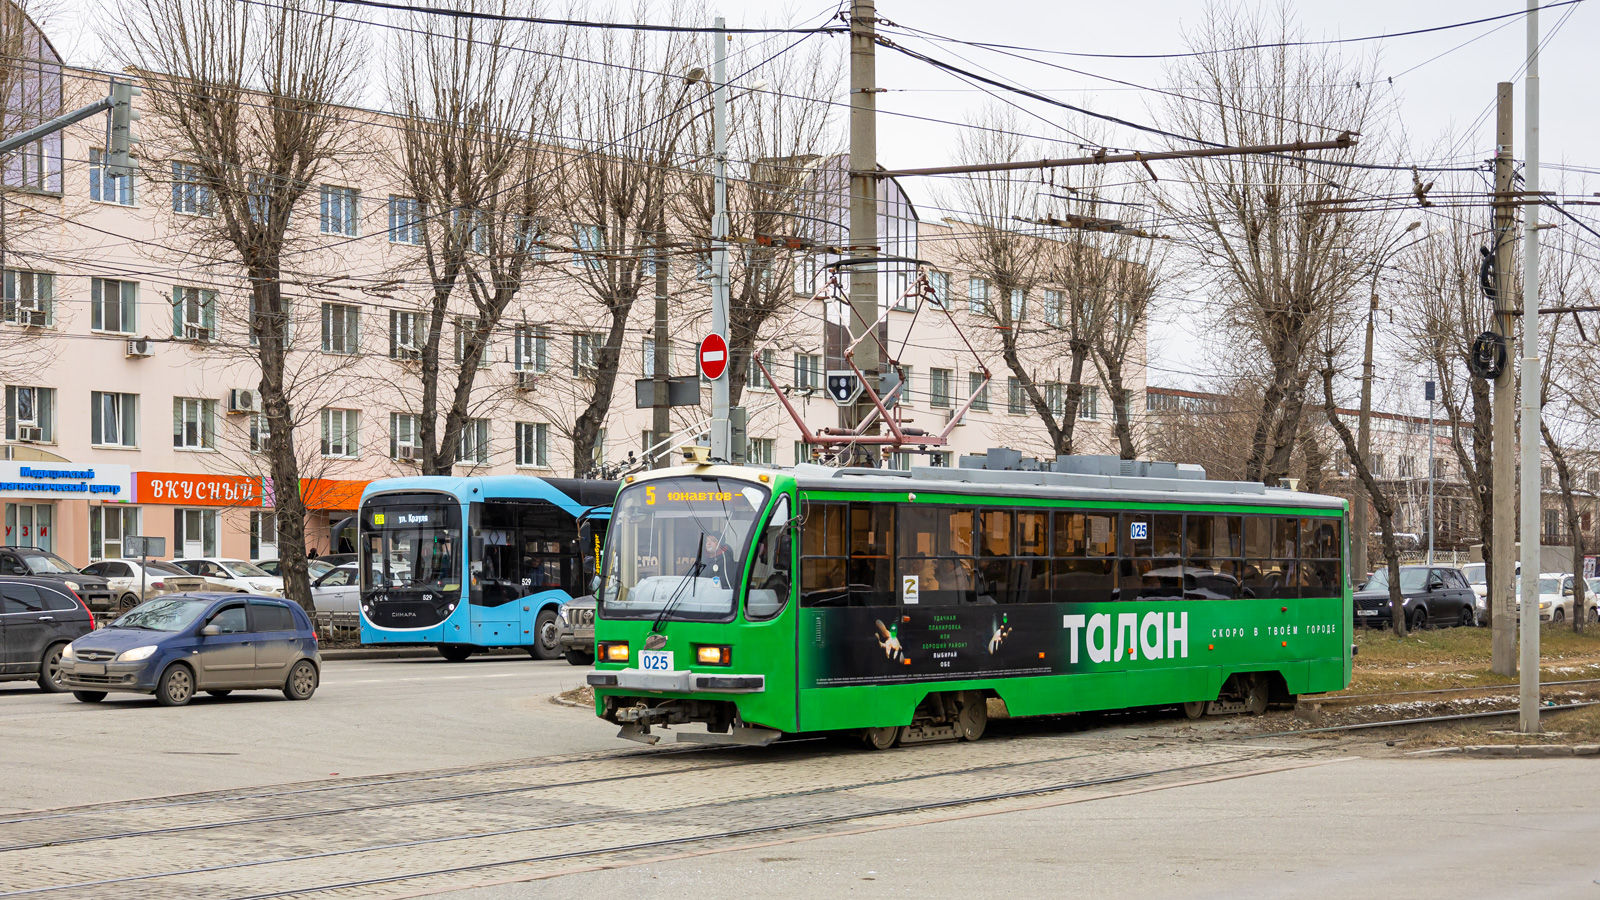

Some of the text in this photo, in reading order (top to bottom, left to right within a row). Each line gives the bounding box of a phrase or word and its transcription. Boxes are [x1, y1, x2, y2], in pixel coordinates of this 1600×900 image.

[20, 466, 95, 479] Медицинский
[89, 484, 121, 494] центр
[151, 478, 253, 501] ВКУСНЫЙ
[646, 486, 656, 505] 5
[398, 515, 407, 524] ул.
[1130, 523, 1147, 538] 025
[521, 578, 532, 586] 529
[1212, 624, 1336, 638] СКОРО В ТВОЁМ ГОРОДЕ
[933, 651, 957, 659] ВЫБИРАЙ
[643, 655, 669, 670] 025
